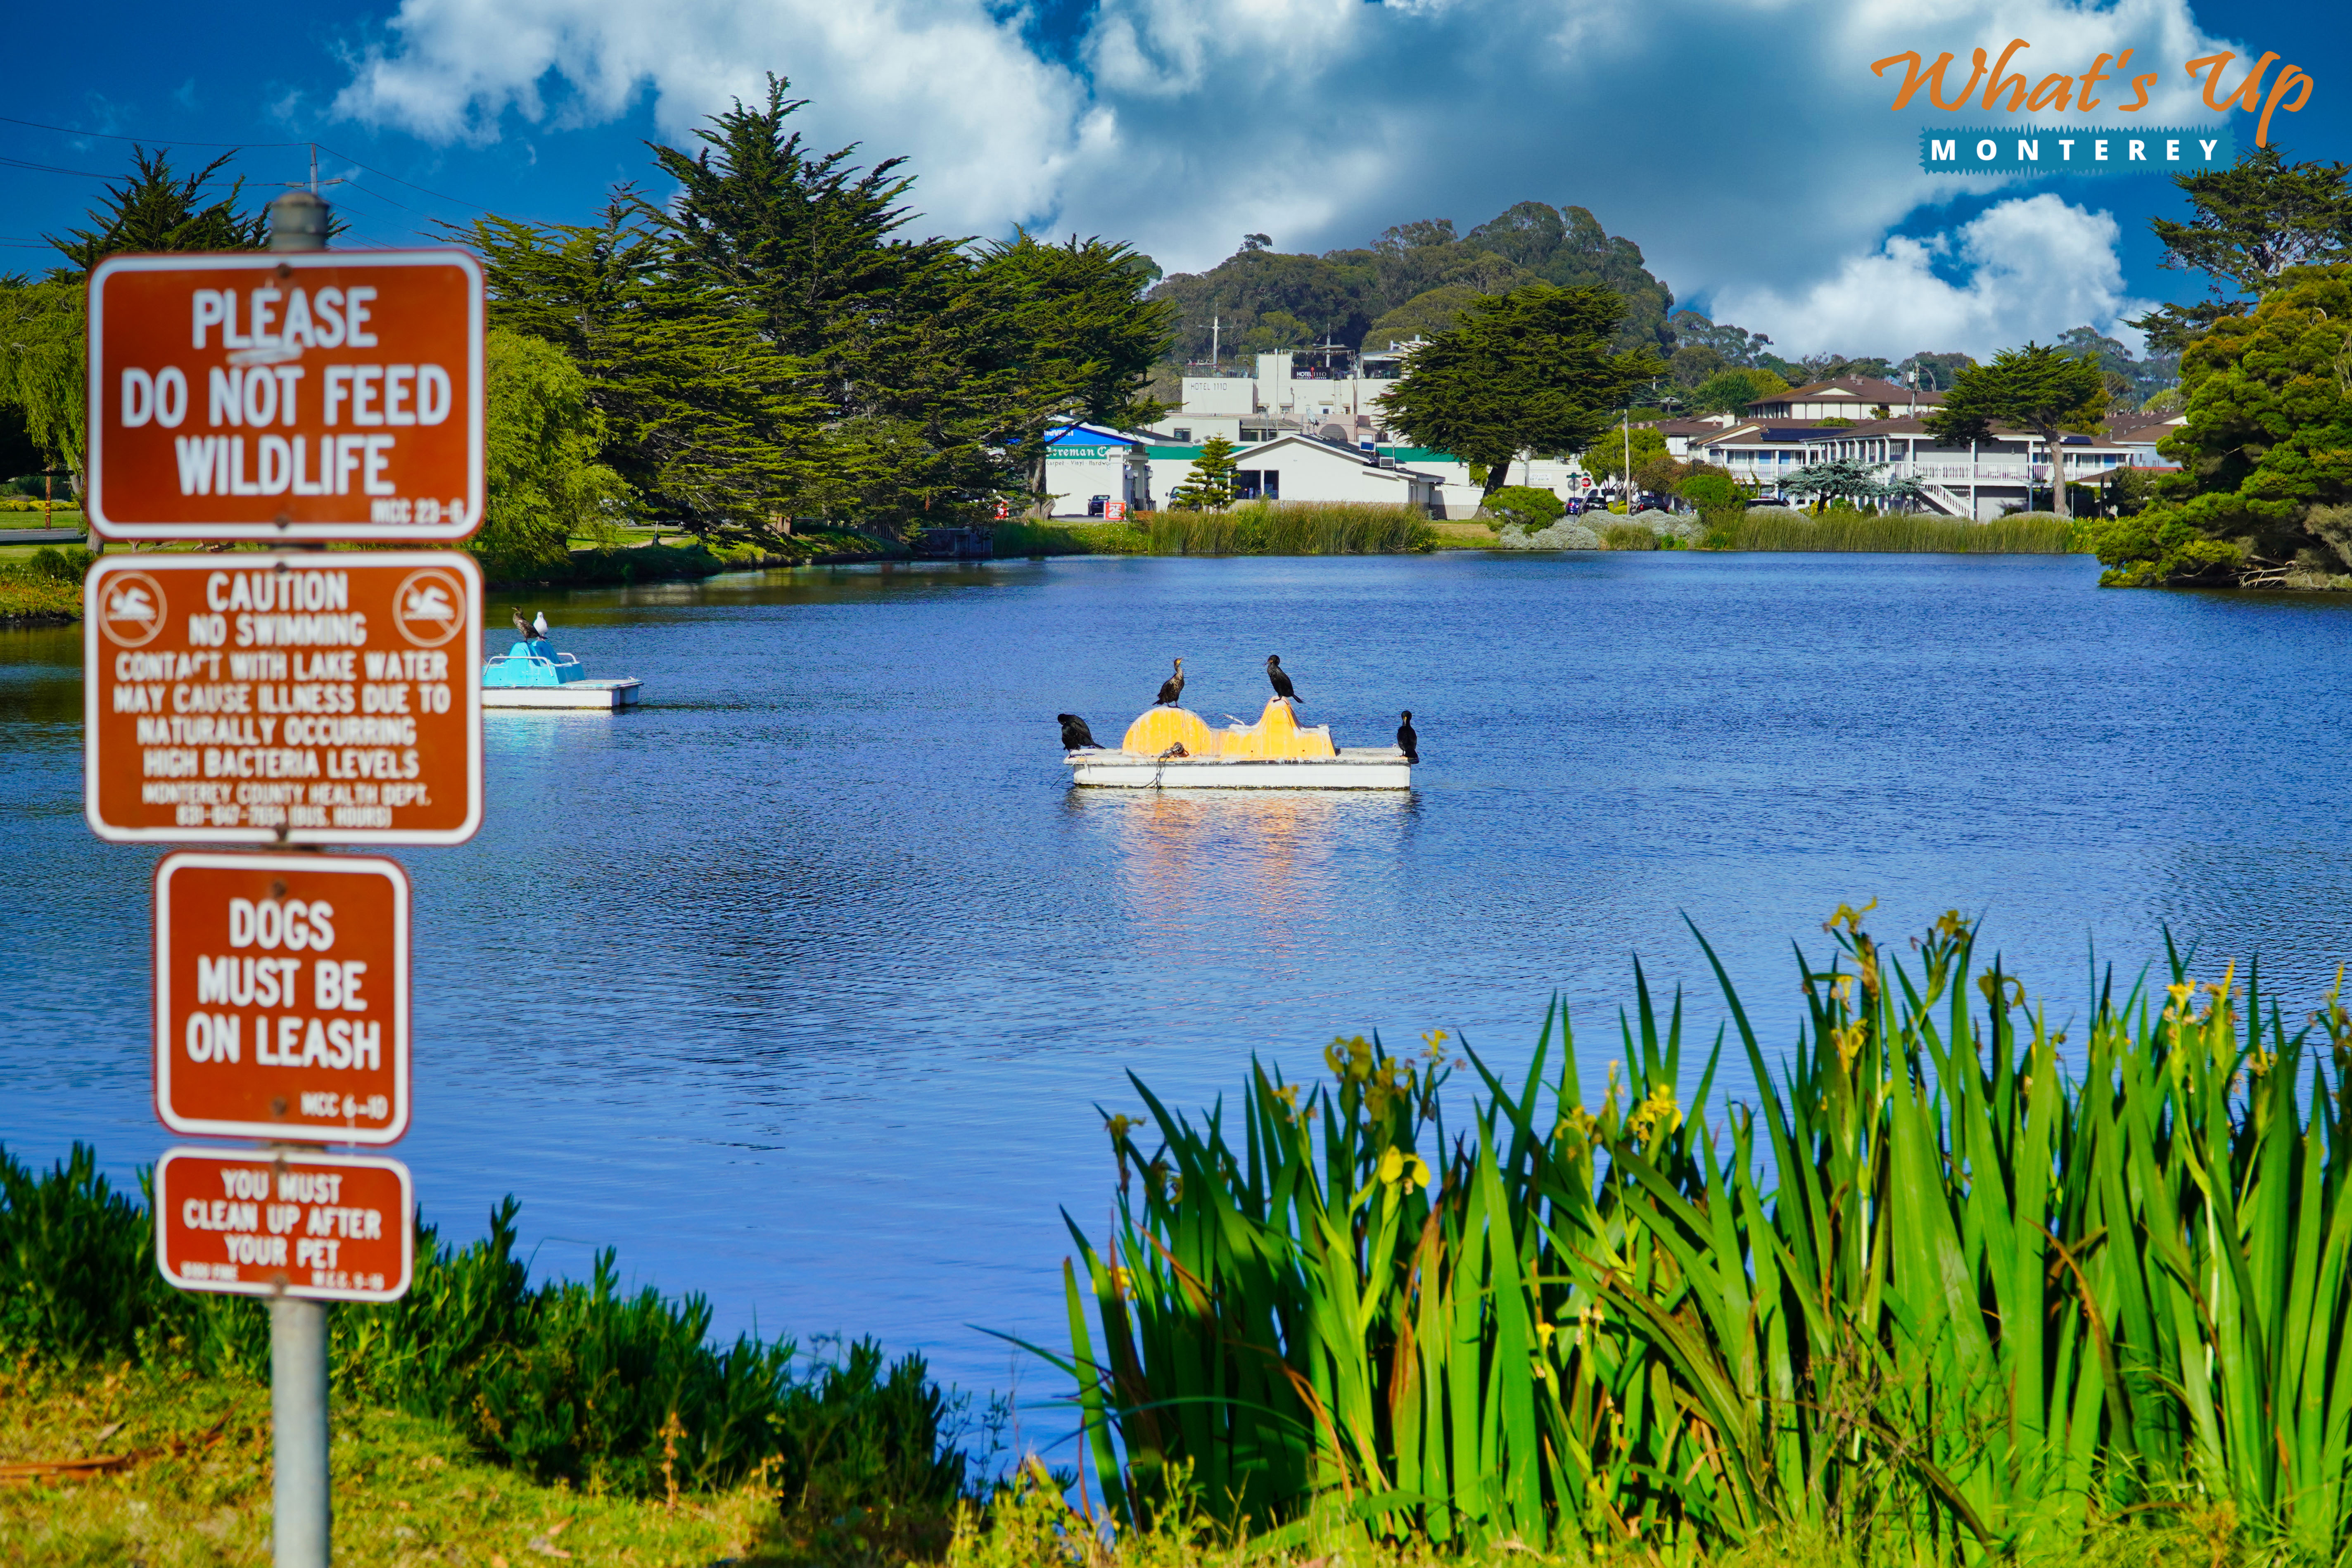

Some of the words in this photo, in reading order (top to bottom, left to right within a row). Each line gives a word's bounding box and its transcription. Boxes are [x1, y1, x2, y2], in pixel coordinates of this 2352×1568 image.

[192, 286, 377, 349] PLEASE
[121, 366, 188, 428] DO
[209, 365, 305, 427] NOT
[324, 364, 452, 426] FEED
[175, 434, 395, 495] WILDLIFE
[371, 498, 412, 523] MCC
[207, 572, 348, 612] CAUTION
[189, 614, 226, 647] NO
[235, 613, 367, 646] SWIMMING
[229, 651, 287, 680] WITH
[294, 651, 357, 680] LAKE
[364, 651, 448, 680] WATER
[113, 684, 166, 713] MAY
[173, 684, 251, 713] CAUSE
[258, 684, 355, 713] ILLNESS
[362, 684, 410, 713] DUE
[418, 684, 451, 713] TO
[137, 716, 277, 745] NATURALLY
[284, 716, 417, 745] OCCURRING
[143, 748, 197, 777] HIGH
[204, 749, 320, 777] BACTERIA
[326, 749, 419, 778] LEVELS
[142, 781, 233, 805] MONTEREY
[236, 781, 305, 805] COUNTY
[309, 783, 378, 806] HEALTH
[229, 897, 335, 951] DOGS
[198, 954, 301, 1008] MUST
[315, 960, 368, 1011] BE
[186, 1012, 240, 1063] ON
[256, 1015, 381, 1071] LEASH
[301, 1091, 339, 1118] MCC
[220, 1168, 269, 1200] YOU
[277, 1172, 343, 1205] MUST
[183, 1198, 258, 1232] CLEAN
[266, 1203, 301, 1234] UP
[306, 1206, 382, 1240] AFTER
[223, 1233, 288, 1266] YOUR
[296, 1237, 341, 1269] PET
